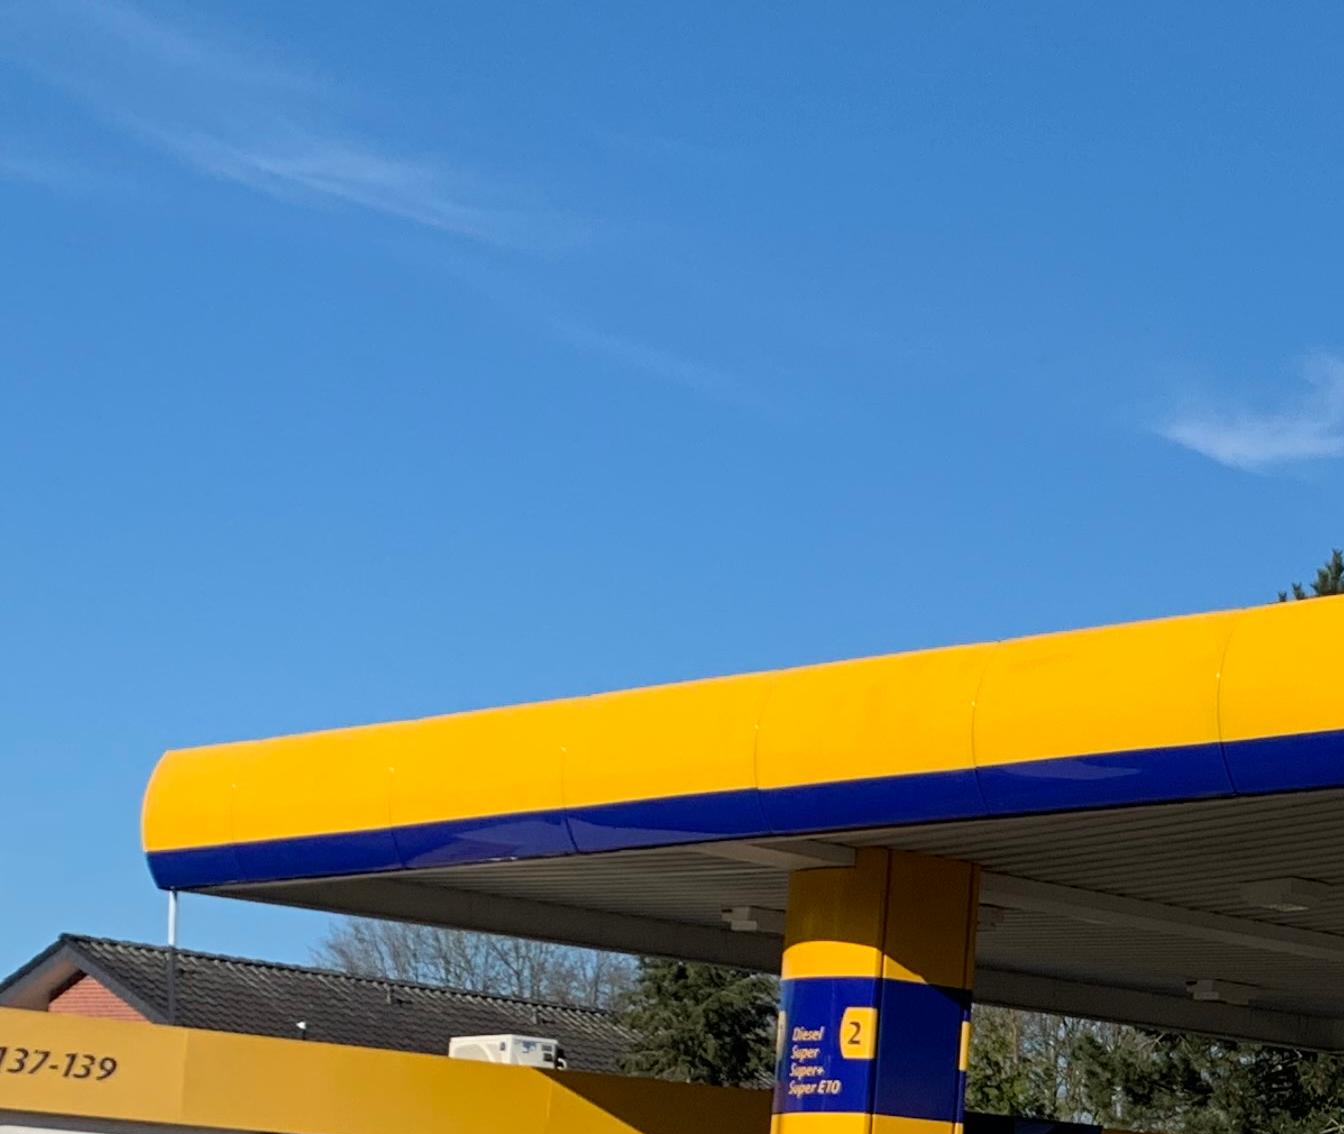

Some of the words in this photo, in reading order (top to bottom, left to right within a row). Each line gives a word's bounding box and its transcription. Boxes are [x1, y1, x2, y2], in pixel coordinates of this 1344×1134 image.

[792, 1026, 825, 1041] Diesel
[847, 1021, 861, 1045] 2
[791, 1046, 820, 1062] Super
[789, 1063, 825, 1080] Super+
[788, 1081, 817, 1098] Super
[818, 1080, 841, 1094] E10
